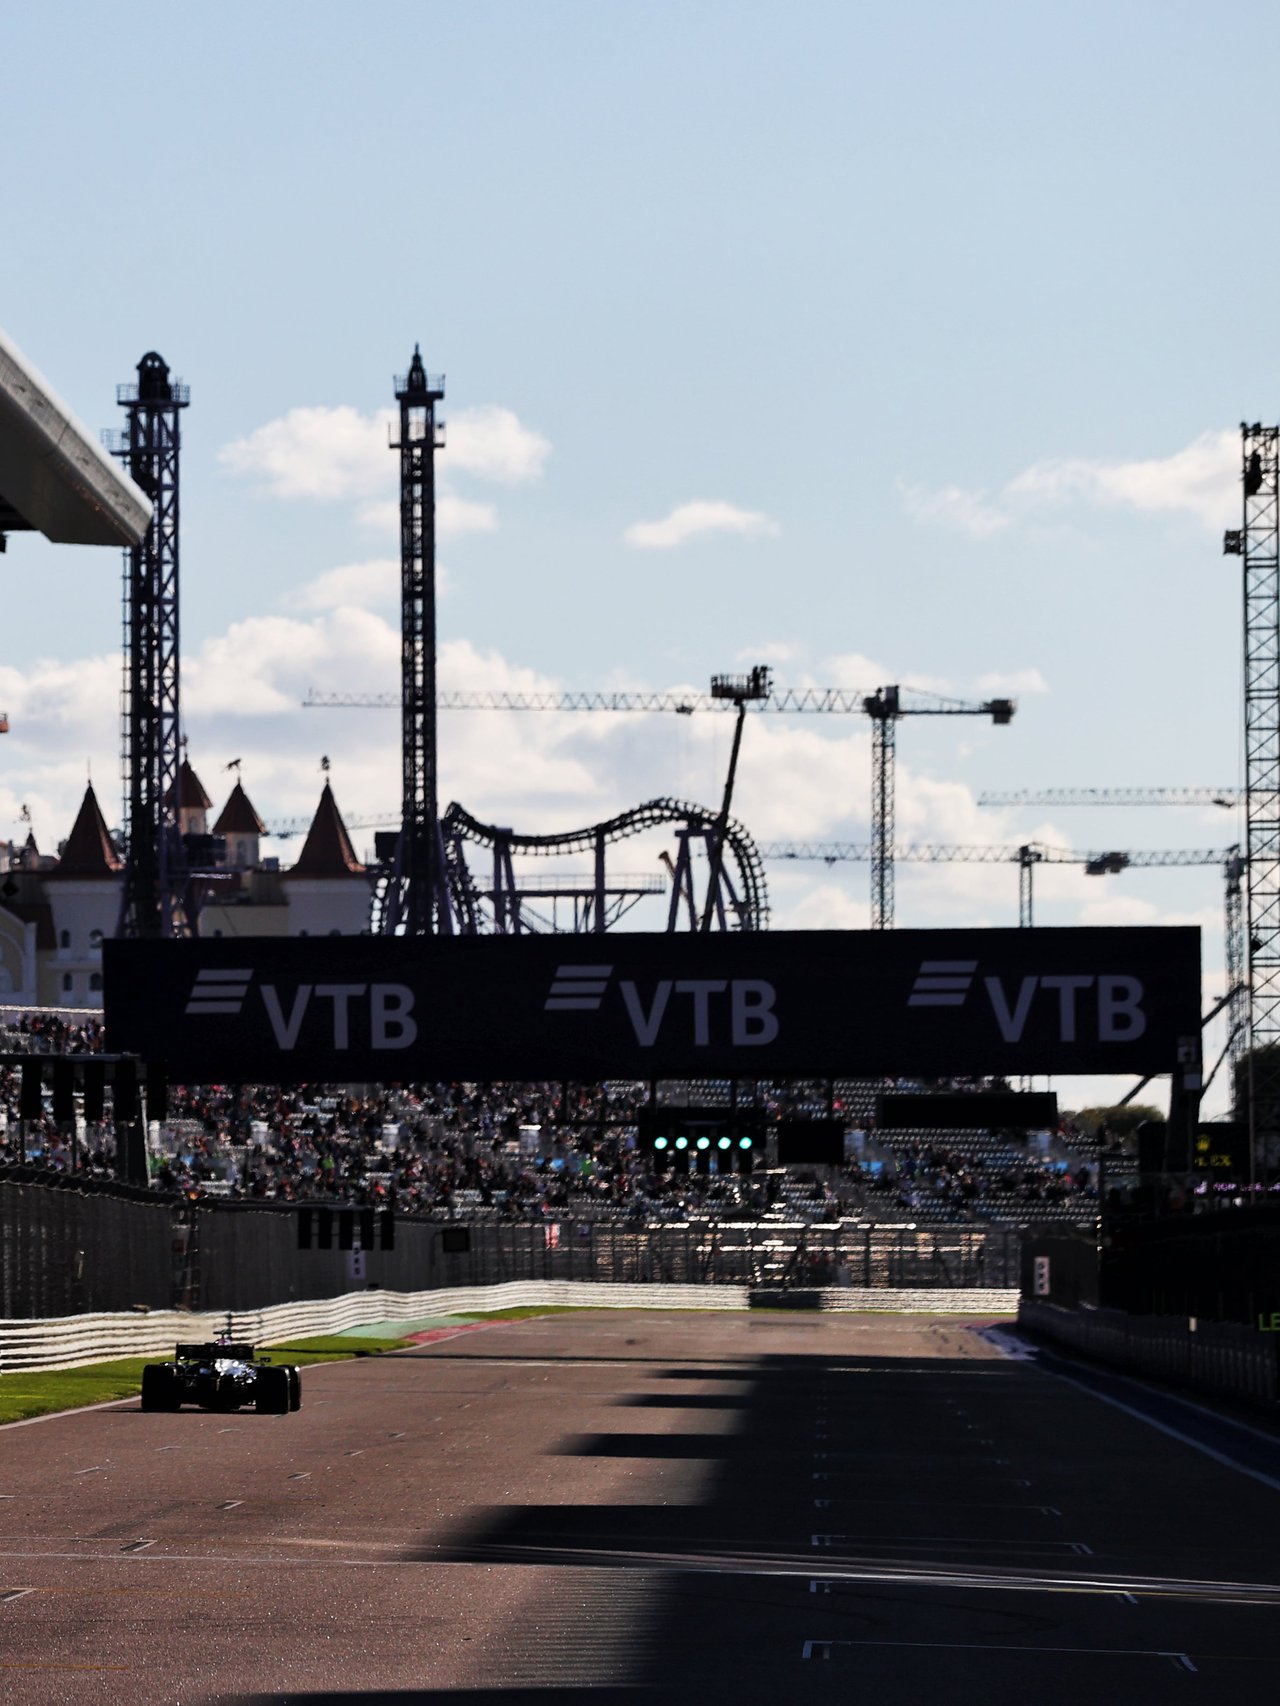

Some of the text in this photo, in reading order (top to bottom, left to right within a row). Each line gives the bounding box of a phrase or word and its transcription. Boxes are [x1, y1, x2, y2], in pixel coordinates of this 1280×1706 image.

[260, 984, 417, 1050] VTB
[619, 979, 779, 1047] VTB
[984, 975, 1146, 1042] VTB
